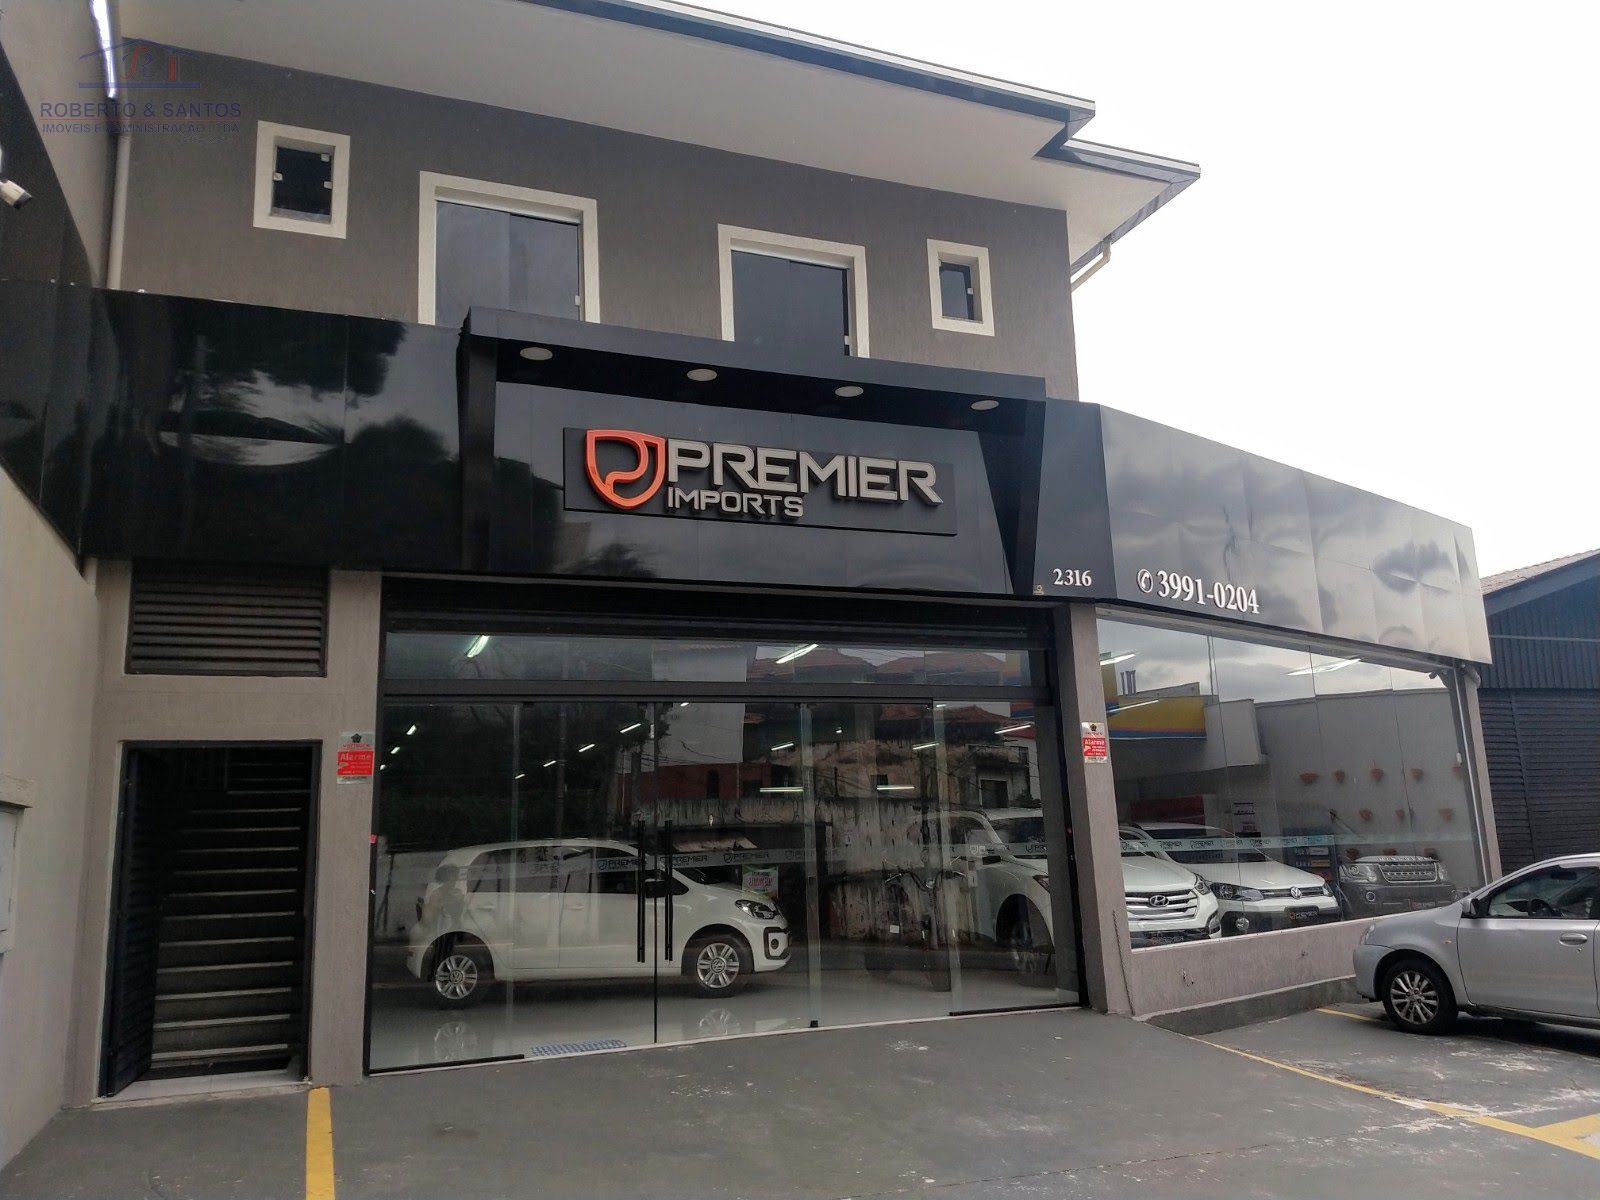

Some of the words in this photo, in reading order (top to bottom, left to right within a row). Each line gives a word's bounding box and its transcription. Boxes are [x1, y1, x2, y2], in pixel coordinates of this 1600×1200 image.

[667, 438, 944, 506] PREMIER
[667, 487, 804, 519] IMPORTS
[1053, 568, 1092, 587] 2316
[1157, 569, 1261, 614] 3991-0204
[608, 859, 648, 867] PREMIE
